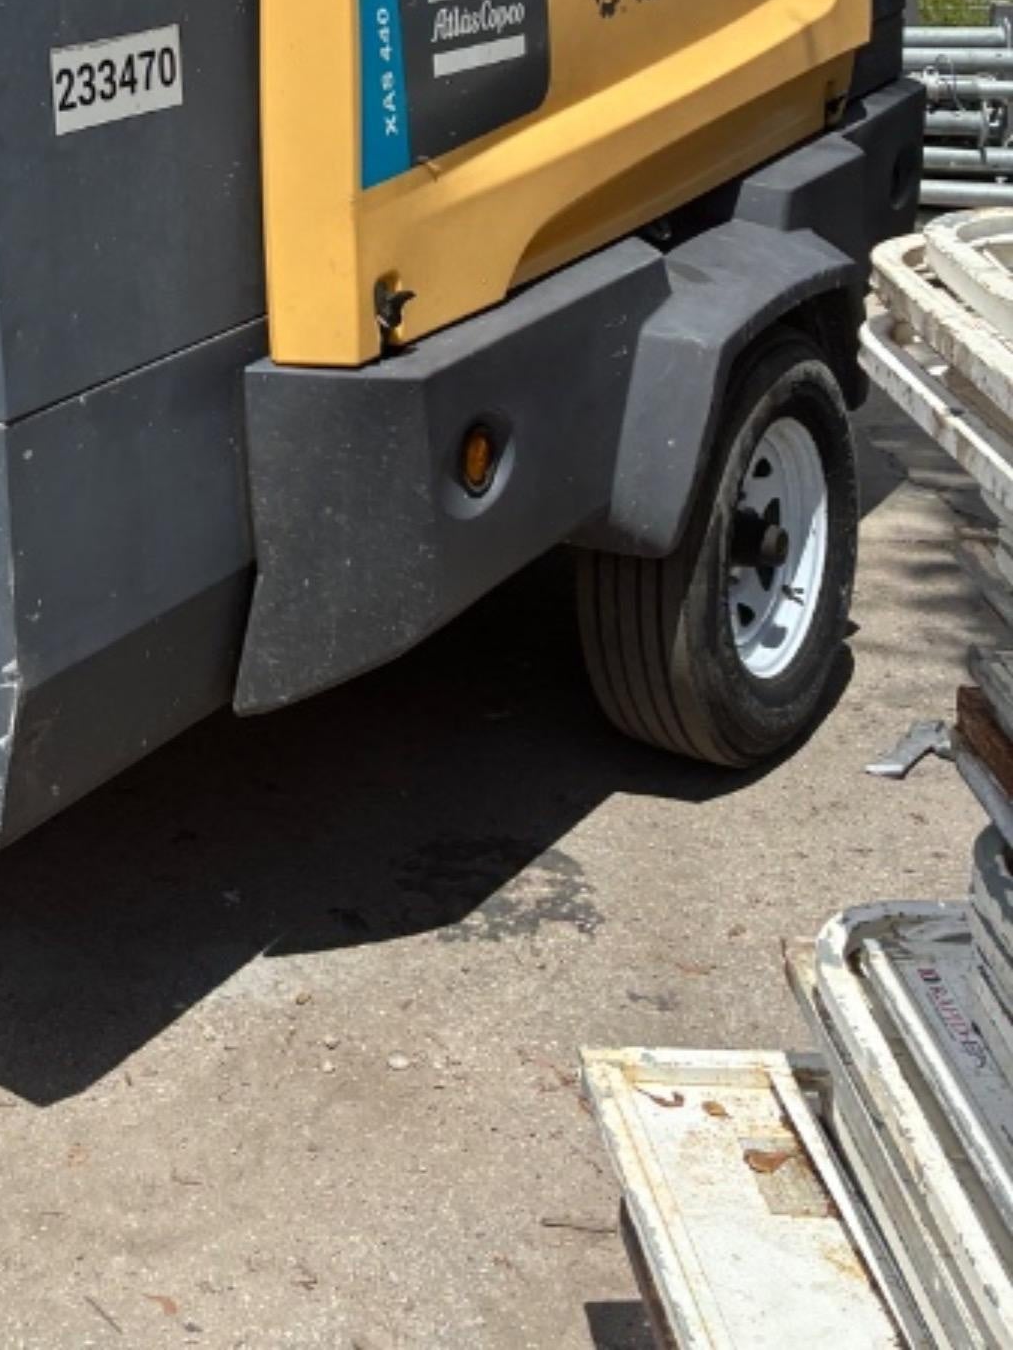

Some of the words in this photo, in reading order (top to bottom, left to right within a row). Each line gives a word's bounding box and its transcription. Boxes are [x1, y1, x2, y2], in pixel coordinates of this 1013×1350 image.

[376, 7, 393, 62] 440
[55, 46, 177, 112] 233470
[380, 70, 400, 136] XAS
